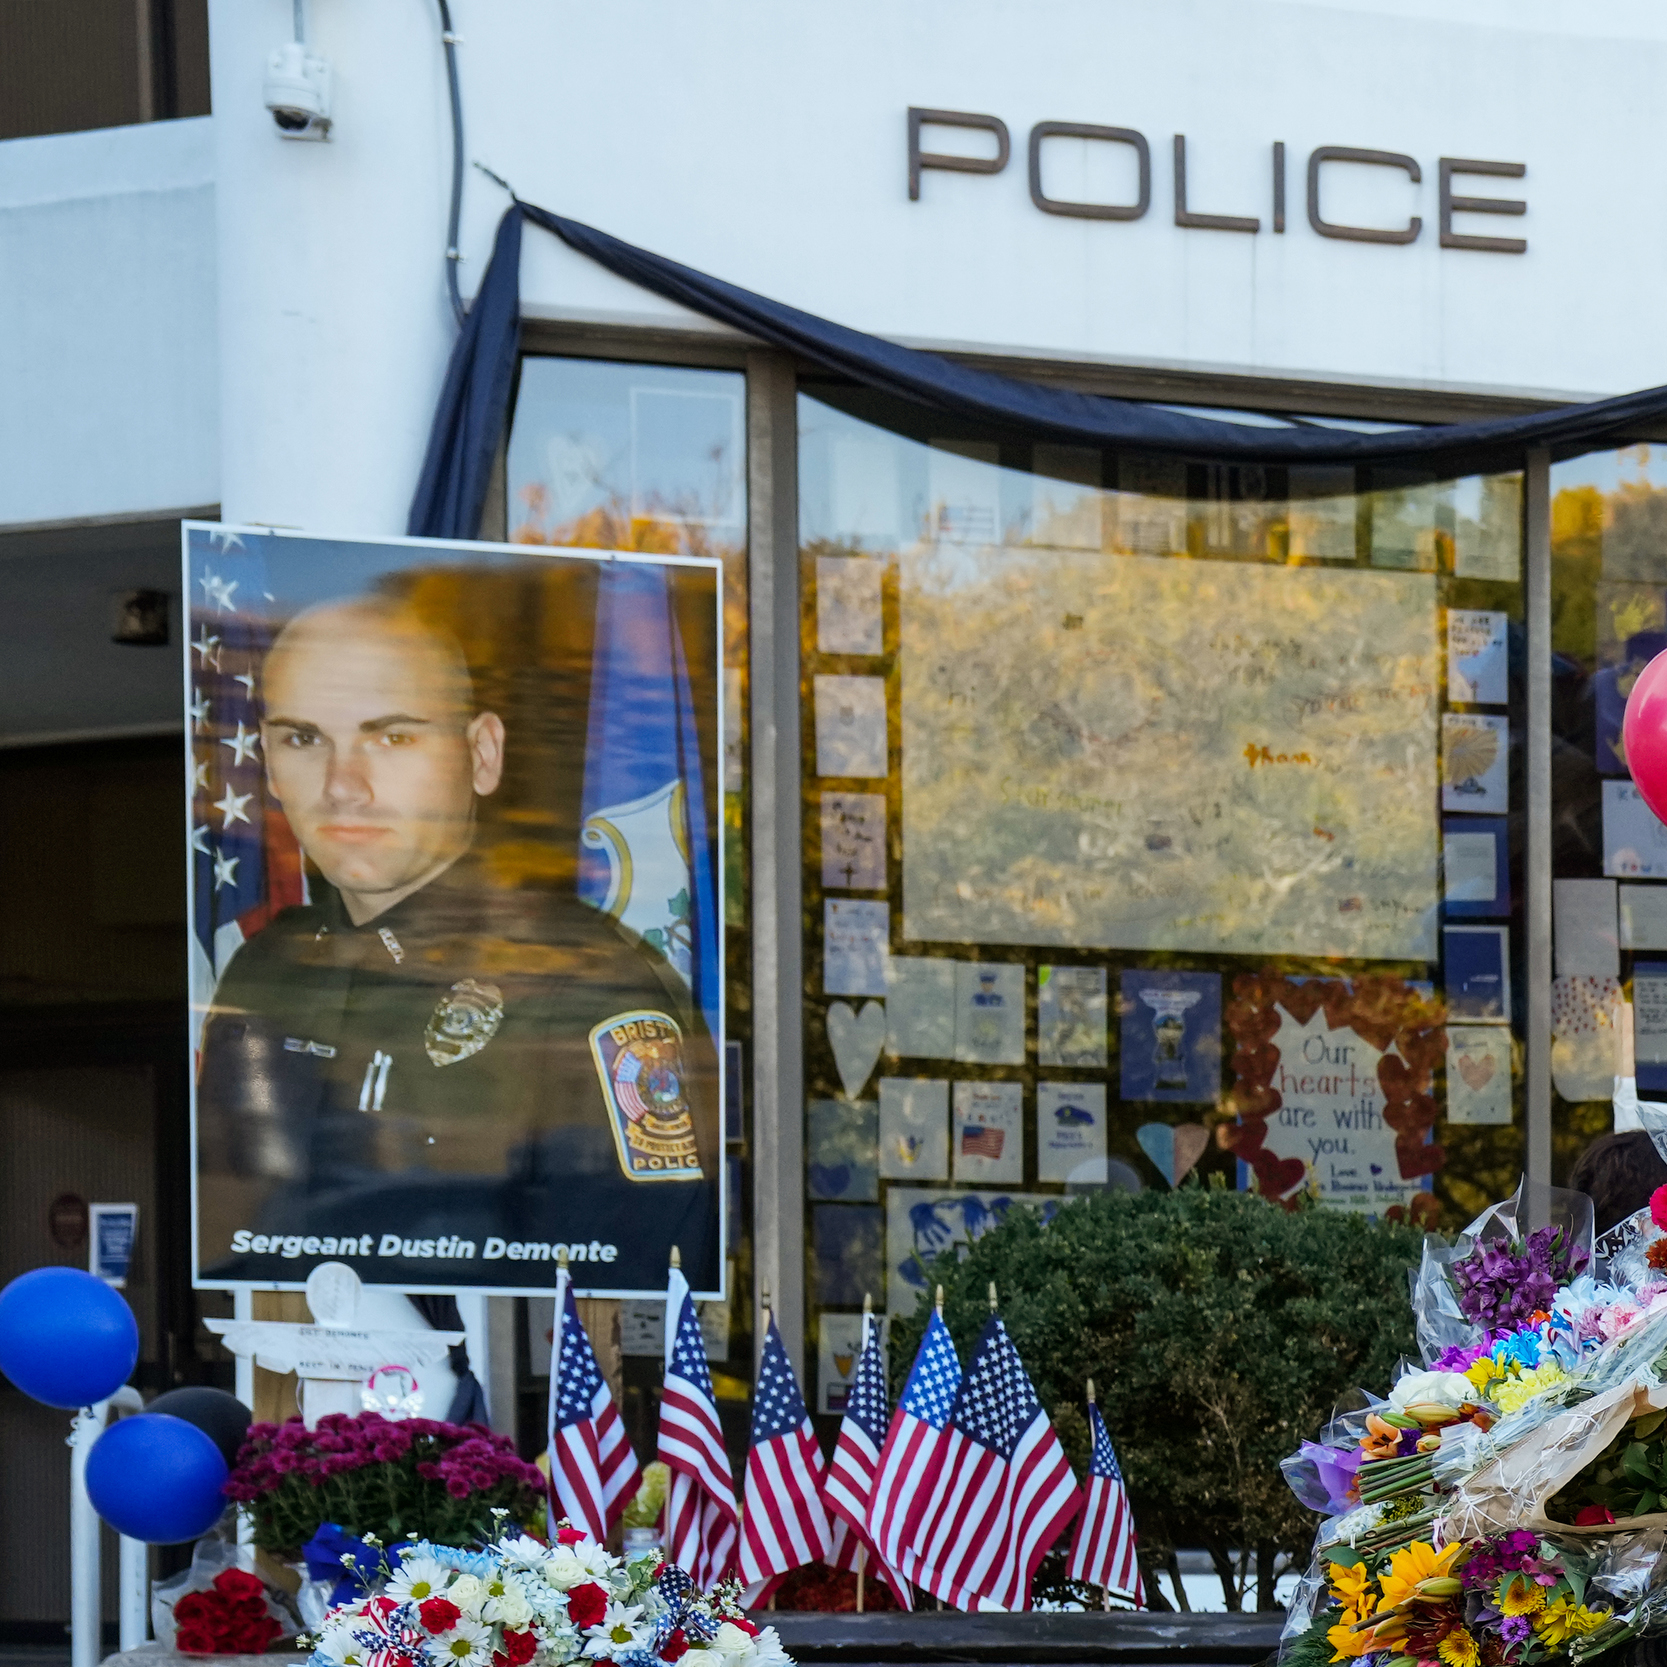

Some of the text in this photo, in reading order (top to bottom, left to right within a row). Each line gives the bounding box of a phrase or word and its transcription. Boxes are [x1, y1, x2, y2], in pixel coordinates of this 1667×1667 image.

[907, 105, 1527, 253] POLICE
[1303, 1035, 1356, 1065] Our
[1280, 1063, 1377, 1098] hearts
[1278, 1098, 1383, 1131] are with
[1308, 1137, 1356, 1165] you.
[231, 1228, 618, 1264] Sergeant Dustin Demonte
